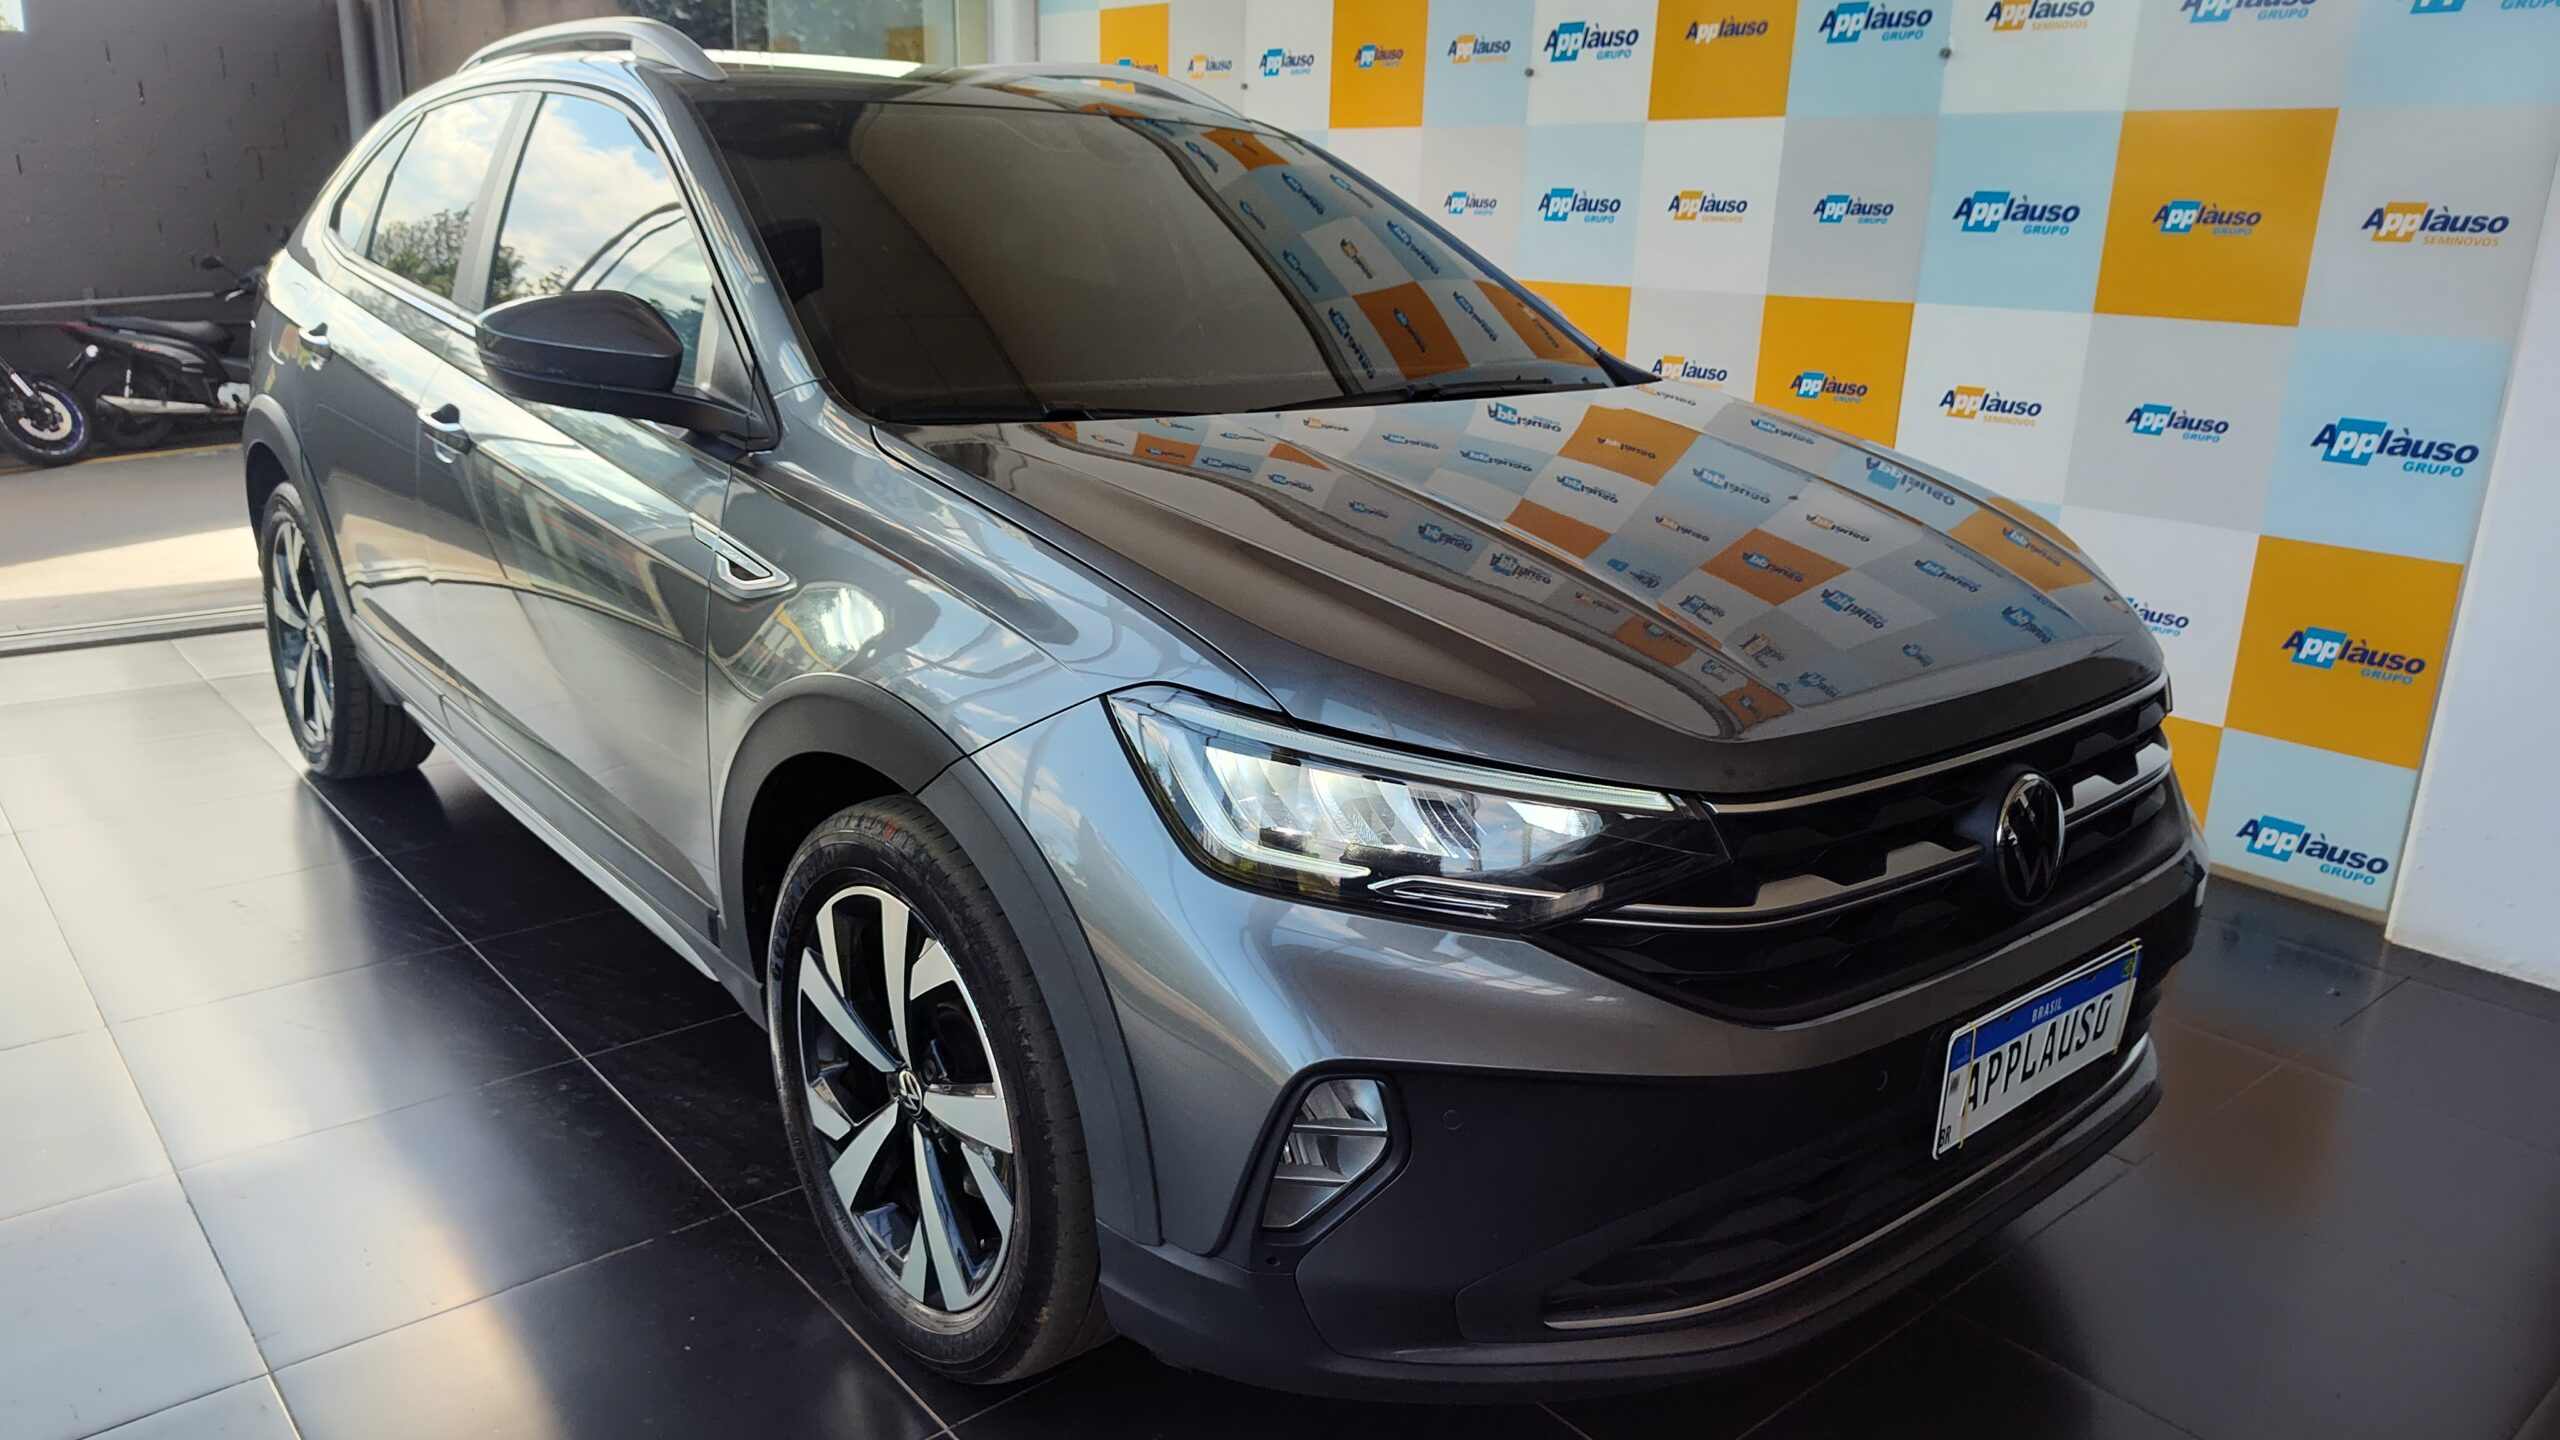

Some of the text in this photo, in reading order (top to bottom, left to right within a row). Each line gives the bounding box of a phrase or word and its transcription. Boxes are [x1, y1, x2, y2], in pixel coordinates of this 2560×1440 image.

[1818, 3, 1933, 39] Applàuso
[2257, 8, 2309, 20] GRUPO
[1543, 23, 1640, 59] Applàuso
[1685, 16, 1769, 45] Applàuso
[1881, 30, 1924, 42] GRUPO
[1537, 189, 1621, 220] Applàuso
[1668, 193, 1748, 220] Applàuso
[1812, 196, 1894, 221] Applàuso
[1952, 194, 2081, 229] Applàuso
[2152, 202, 2262, 231] Applàuso
[2023, 224, 2070, 236] GRUPO
[2361, 205, 2510, 239] Applàuso
[2422, 235, 2499, 247] SEMINOVOS
[1789, 374, 1868, 398] Applàuso
[1939, 389, 2042, 419] Applàuso
[2125, 407, 2229, 436] Applàuso
[2182, 431, 2220, 443] GRUPO
[2310, 423, 2480, 465] Applàuso
[2402, 460, 2464, 478] GRUPO
[2281, 629, 2426, 674] Applàuso
[2360, 668, 2413, 686] GRUPO
[2235, 818, 2389, 874] Applàuso
[2319, 863, 2376, 886] GRUPO
[2031, 997, 2063, 1024] BRASIL
